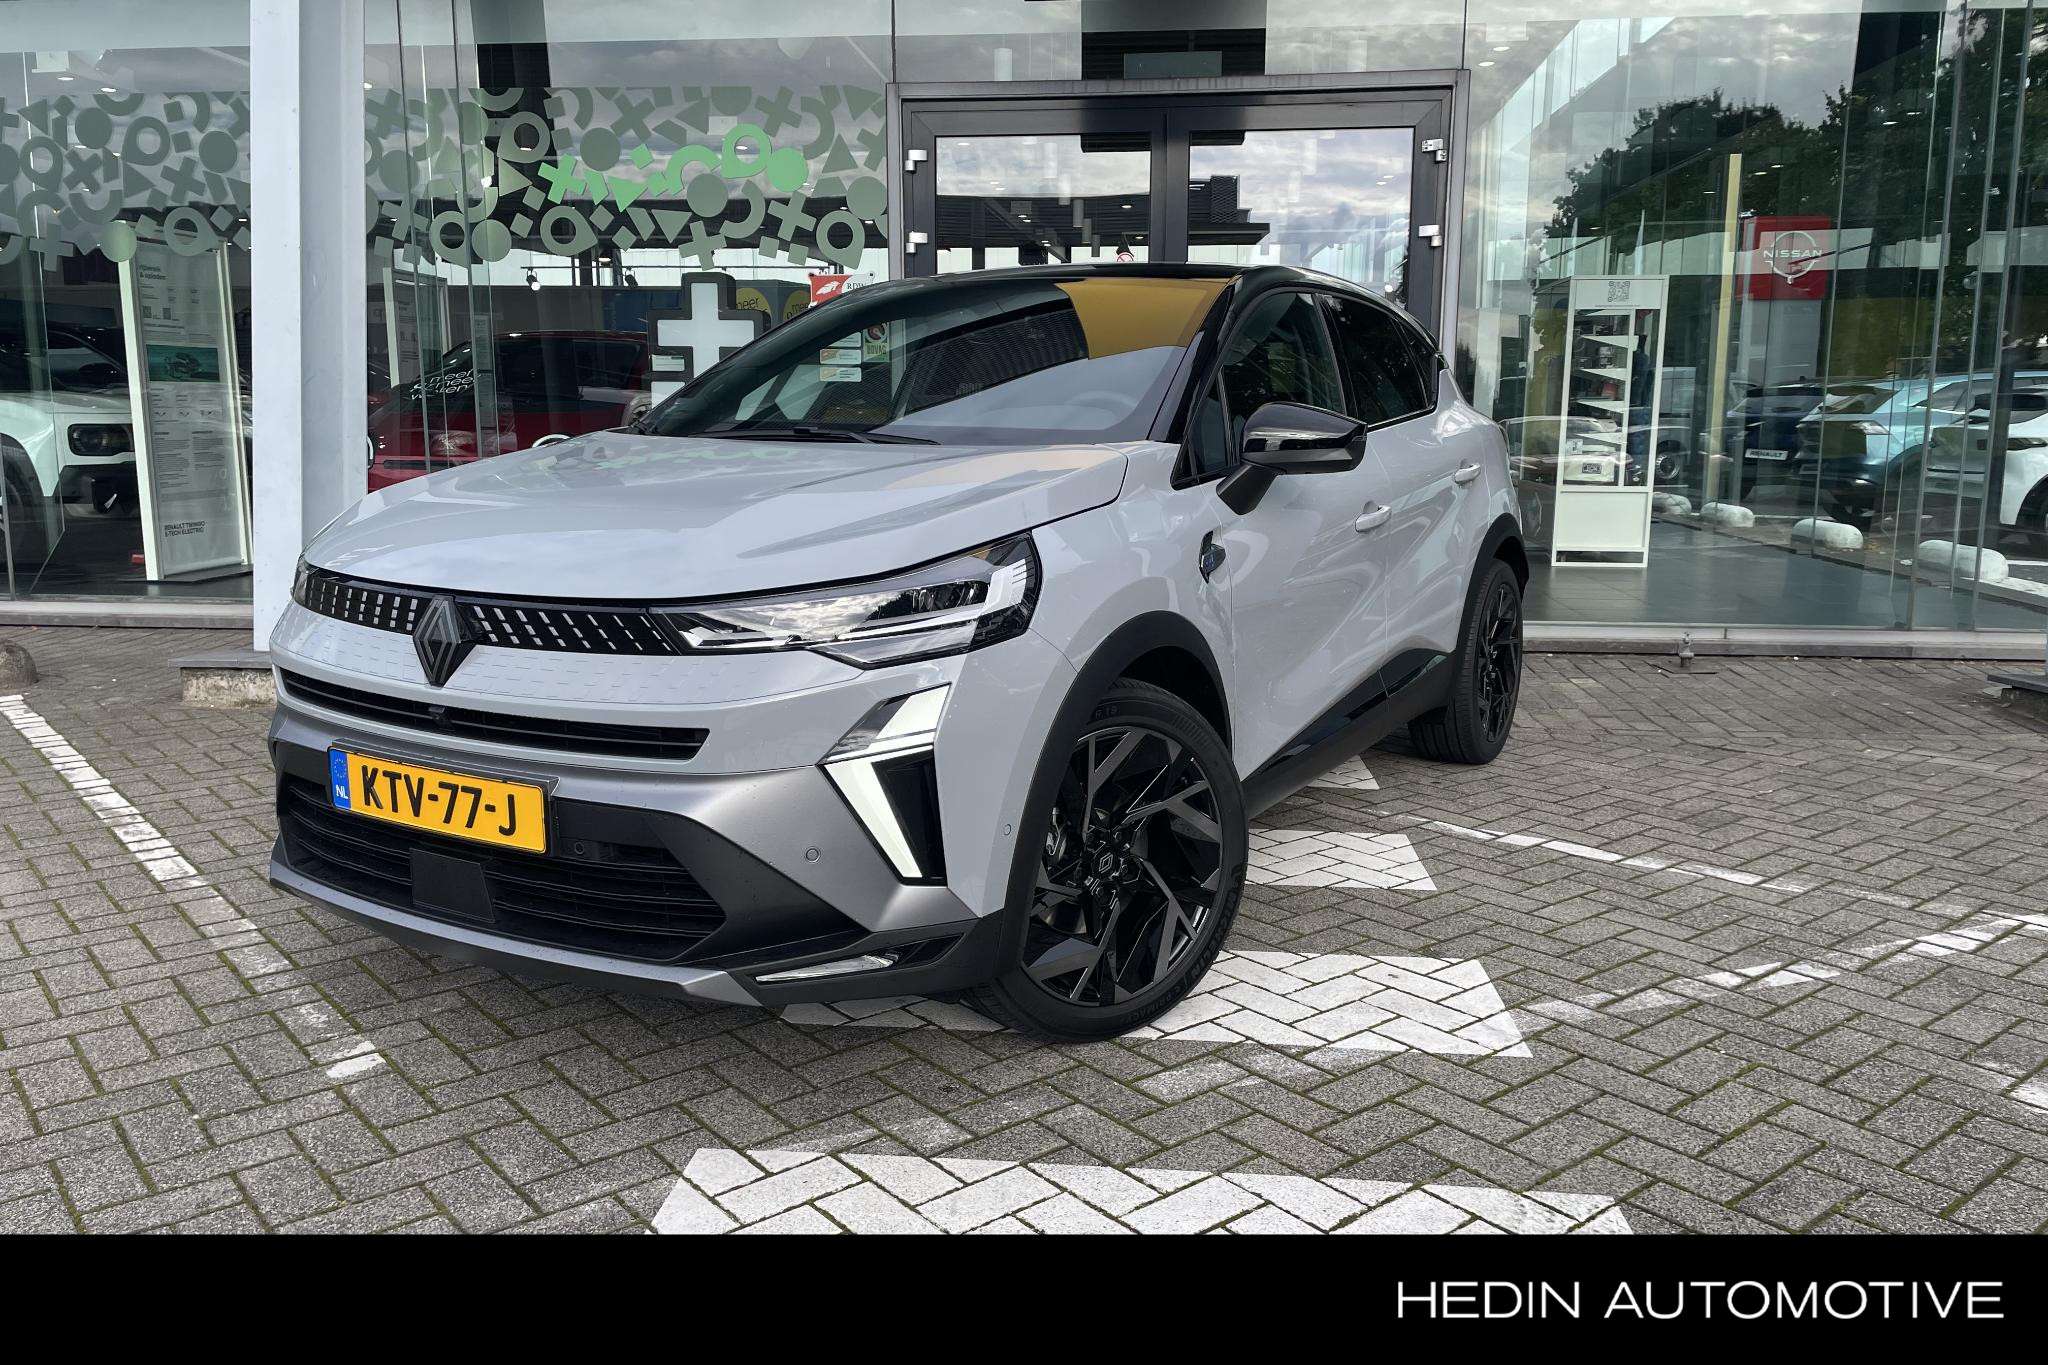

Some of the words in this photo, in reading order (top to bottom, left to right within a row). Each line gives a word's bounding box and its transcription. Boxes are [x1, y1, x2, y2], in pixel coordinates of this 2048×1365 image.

[1763, 249, 1822, 258] NISSAN
[335, 784, 349, 800] NL
[360, 764, 517, 837] KTV-77-J
